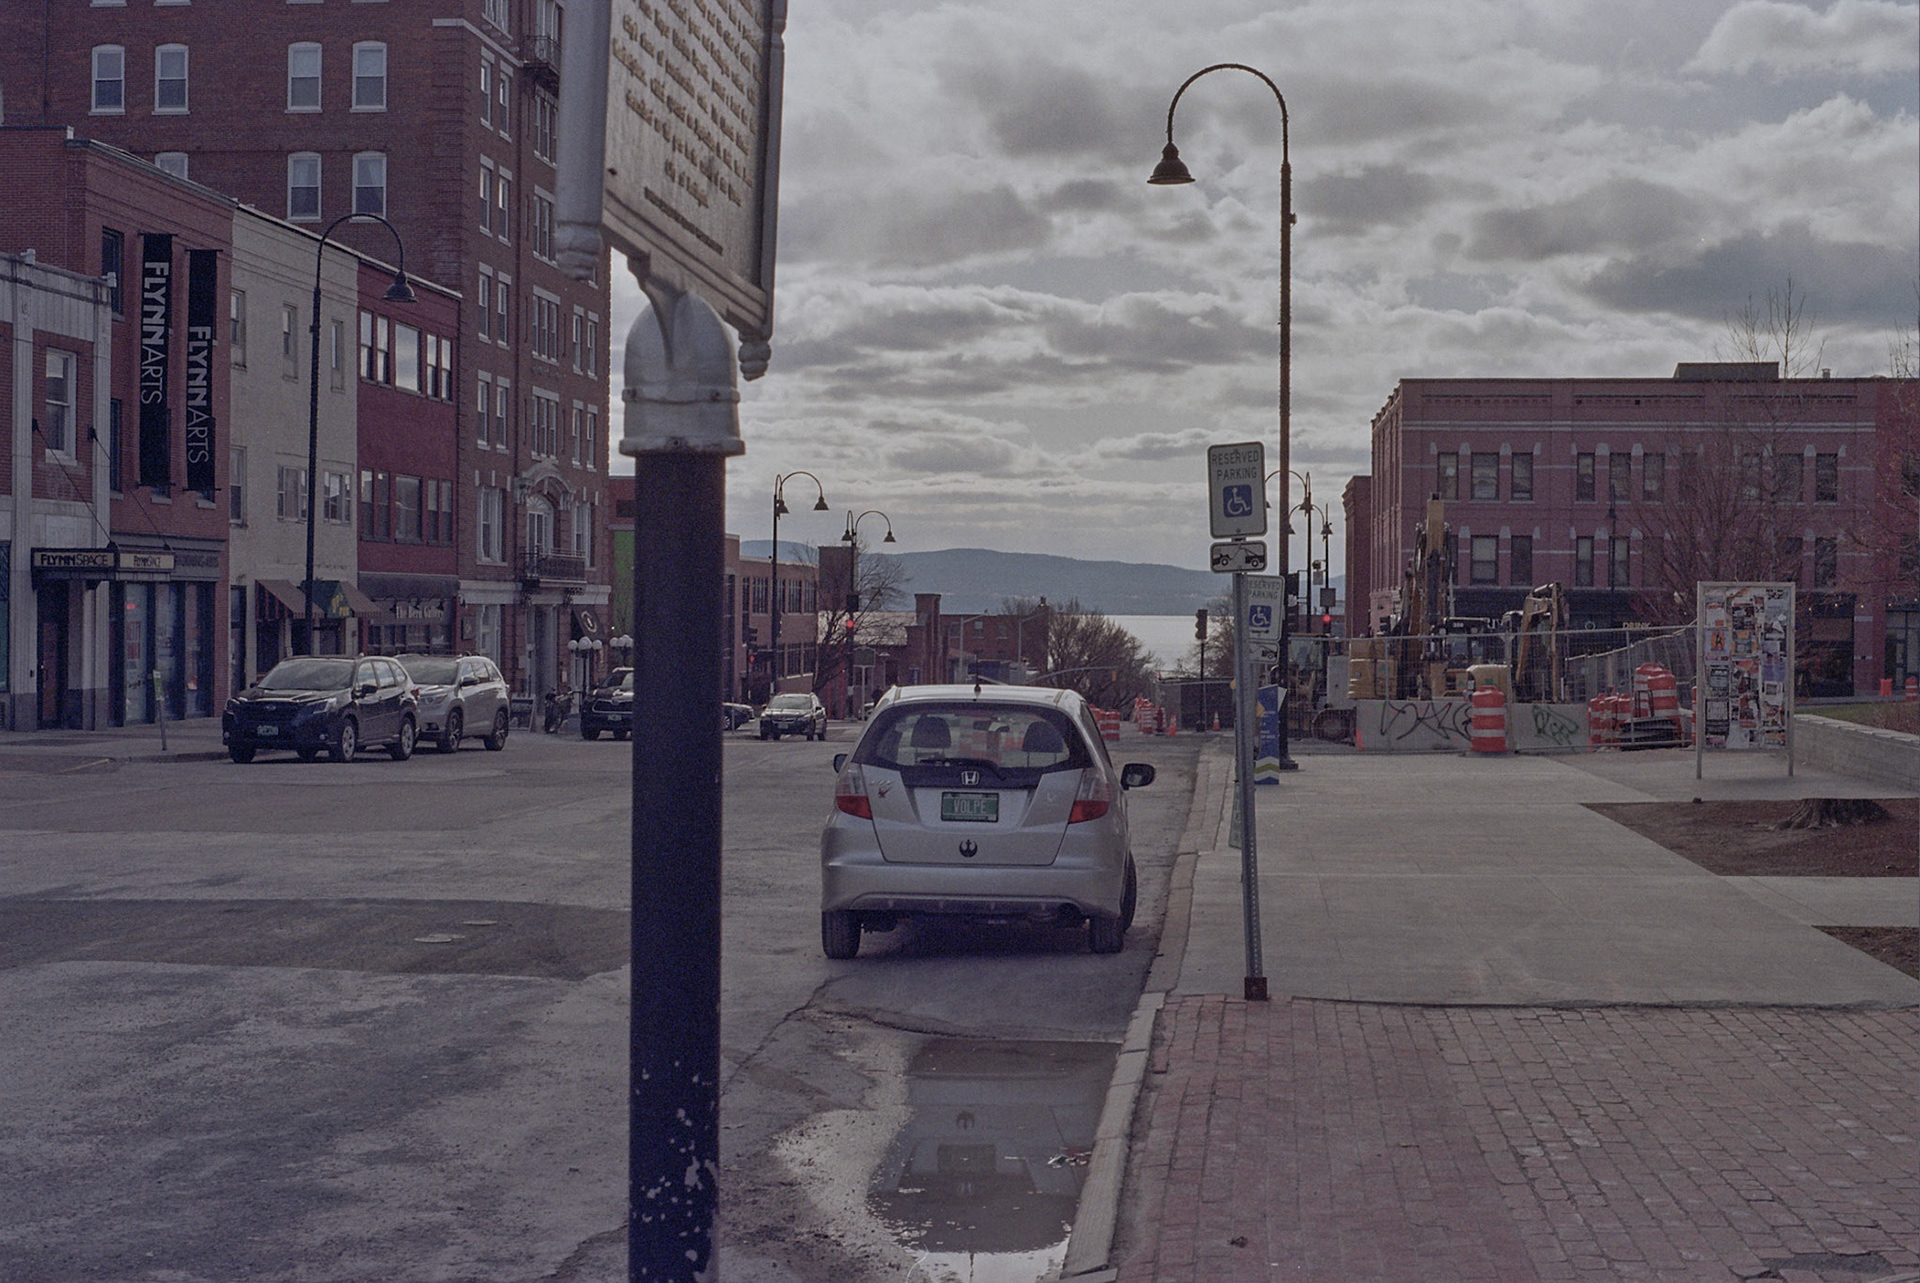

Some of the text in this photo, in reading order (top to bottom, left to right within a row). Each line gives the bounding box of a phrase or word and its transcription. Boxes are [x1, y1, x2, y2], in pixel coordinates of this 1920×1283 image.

[1212, 450, 1259, 465] RESERVED
[1217, 467, 1257, 481] PARKING
[1249, 580, 1281, 591] ESERVED
[954, 799, 987, 814] VOLPE
